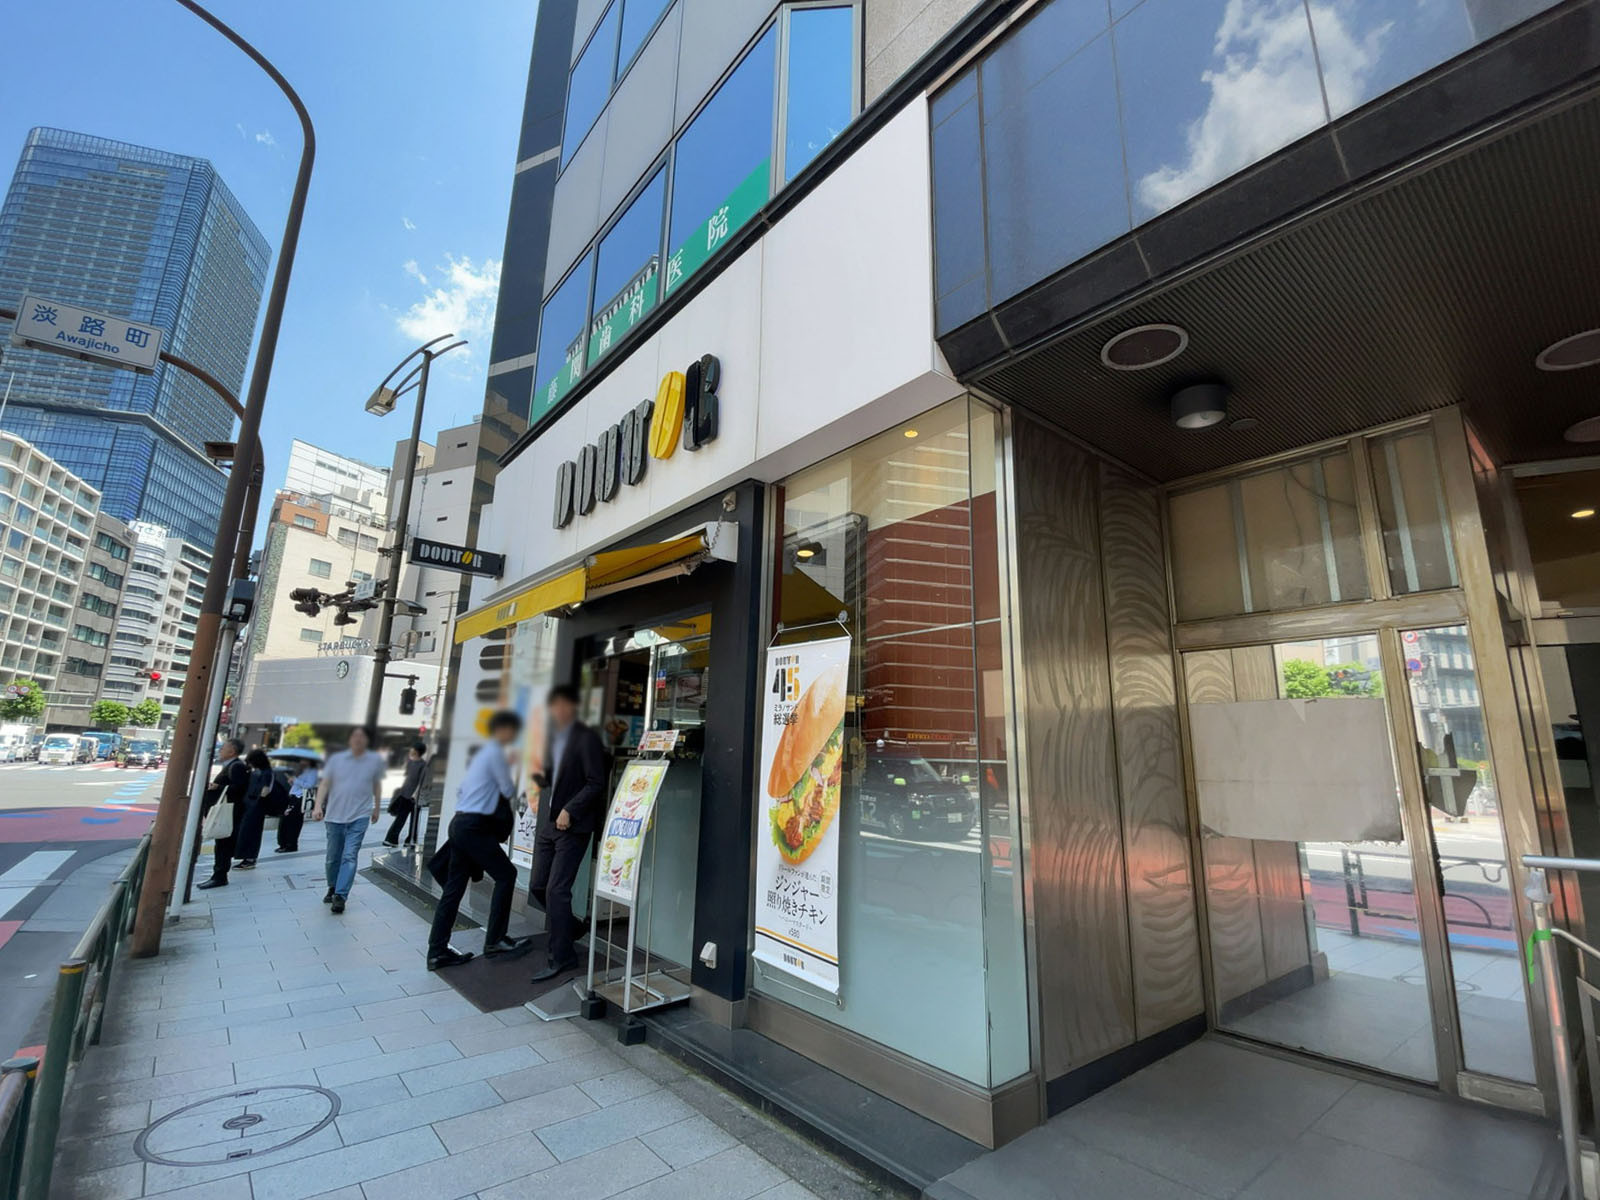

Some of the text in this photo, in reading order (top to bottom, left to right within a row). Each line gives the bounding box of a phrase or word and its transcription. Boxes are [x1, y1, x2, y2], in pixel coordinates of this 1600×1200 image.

[31, 304, 151, 348] 淡路町
[56, 331, 120, 354] Awajicho
[553, 353, 721, 529] DOUTOR
[419, 543, 482, 568] DOUTOR
[318, 639, 371, 651] STARBUCKS
[772, 667, 801, 702] 45
[775, 875, 820, 902] ジンジャー
[766, 890, 829, 925] 照り焼きチキン
